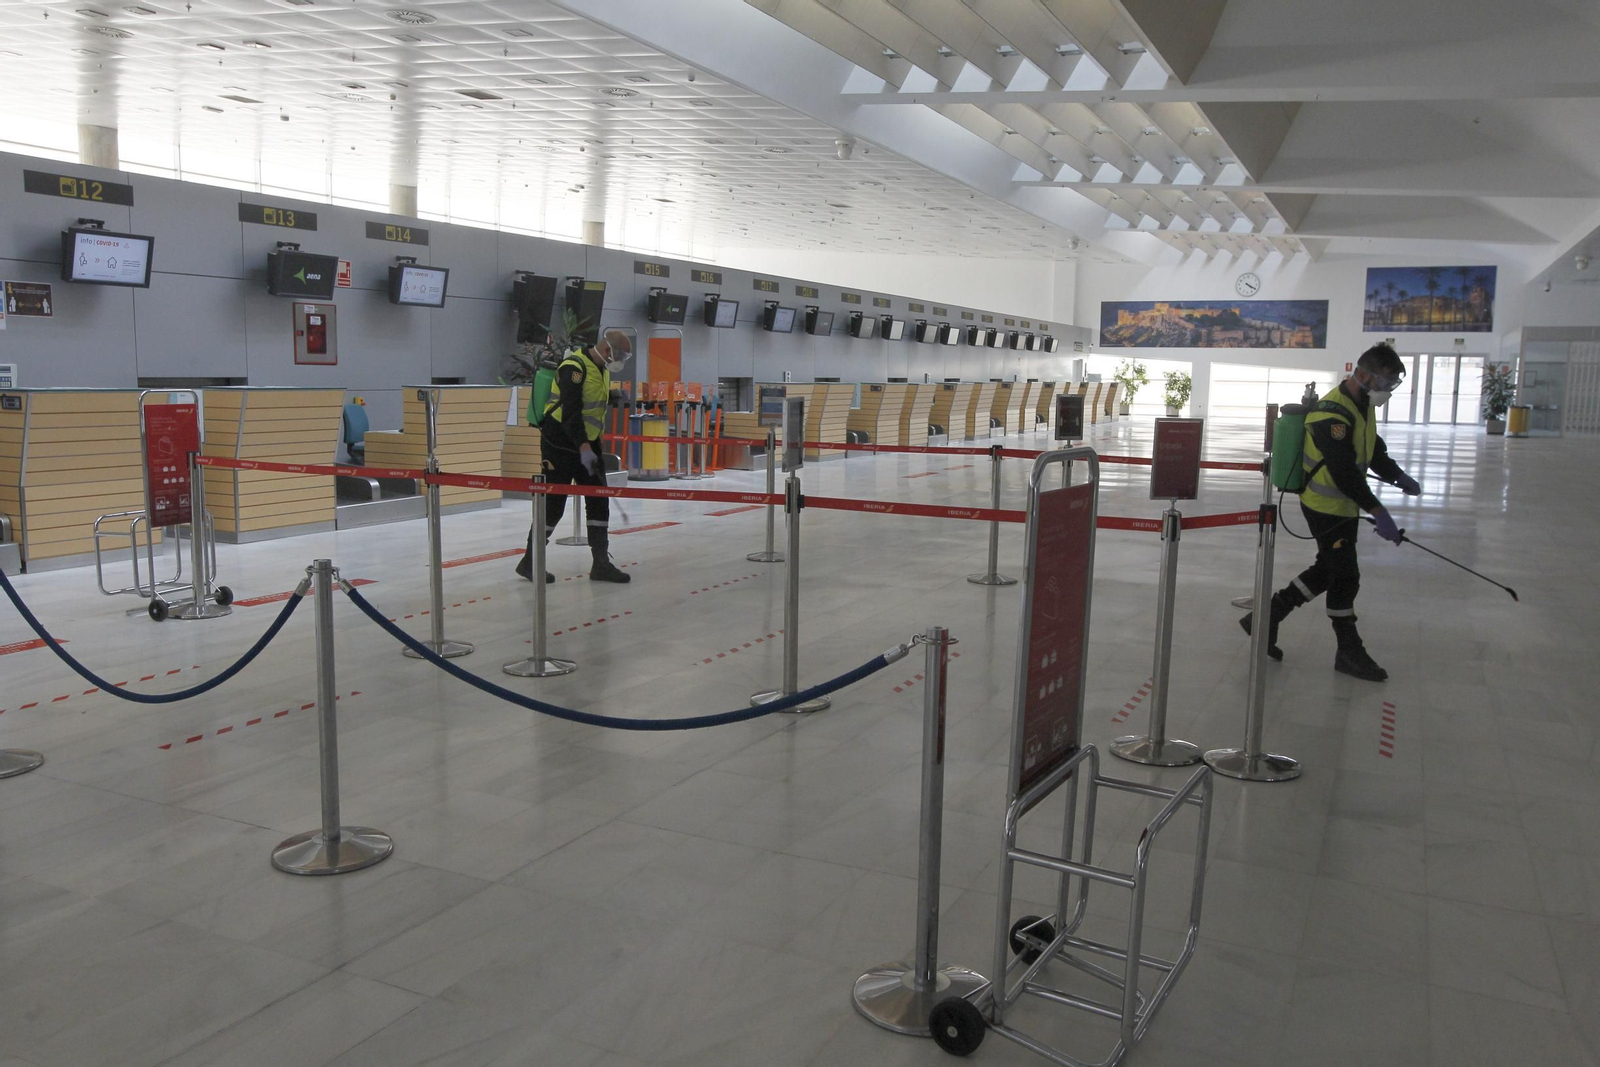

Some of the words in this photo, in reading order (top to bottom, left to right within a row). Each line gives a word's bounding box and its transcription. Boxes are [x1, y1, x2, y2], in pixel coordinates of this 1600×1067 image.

[80, 180, 103, 200] 12
[278, 210, 295, 227] 13
[397, 229, 411, 242] 14
[80, 238, 92, 246] info
[650, 265, 660, 275] 15
[706, 273, 714, 283] 16
